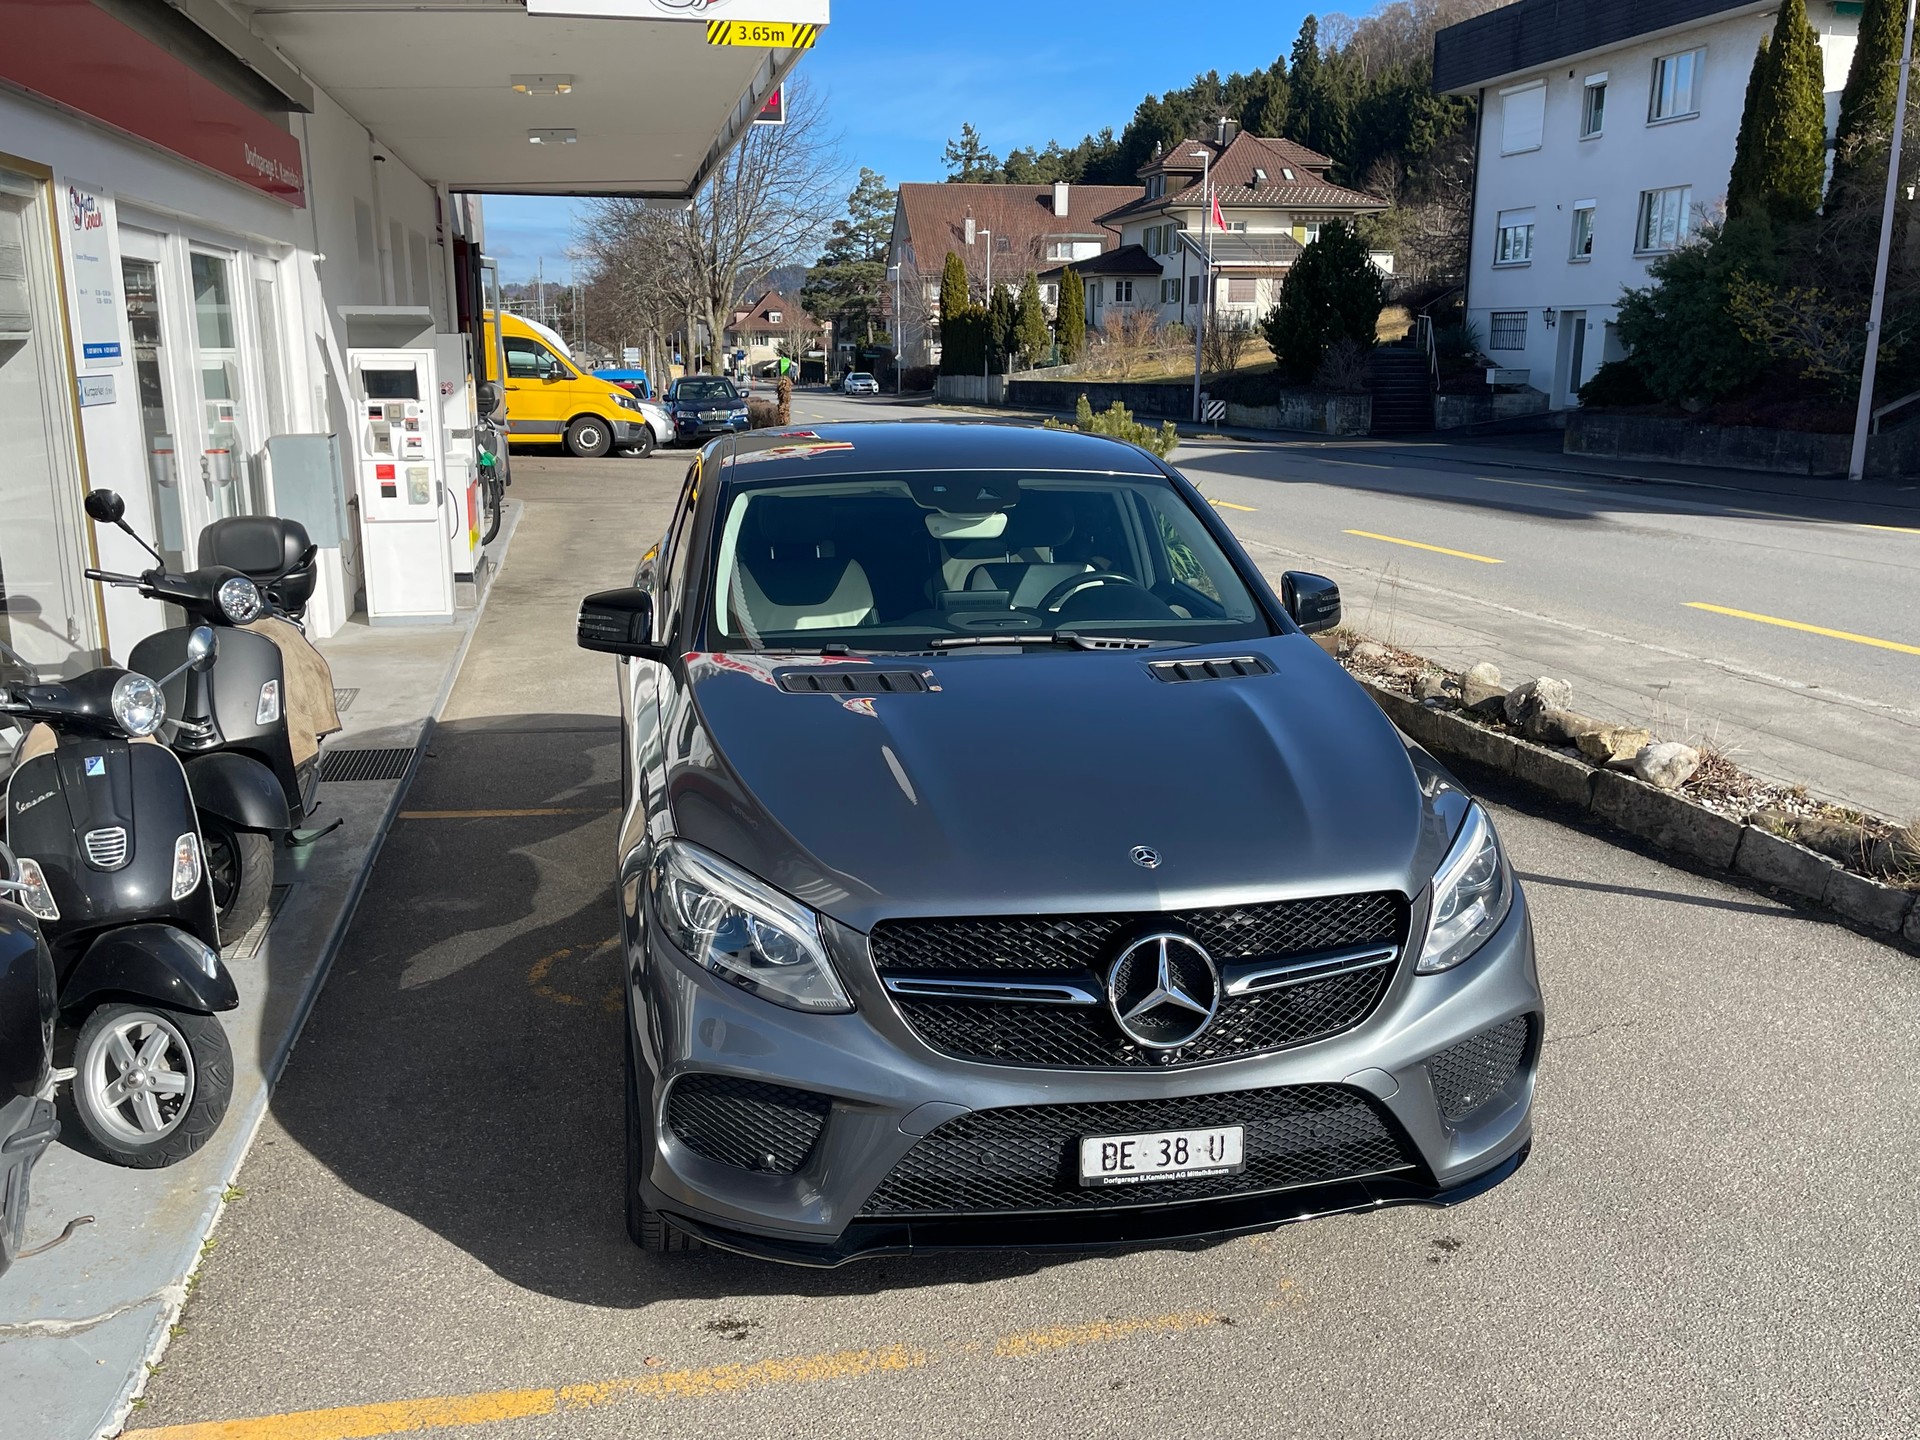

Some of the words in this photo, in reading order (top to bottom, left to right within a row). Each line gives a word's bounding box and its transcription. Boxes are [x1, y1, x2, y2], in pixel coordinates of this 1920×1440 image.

[738, 26, 785, 42] 3.65m
[1102, 1141, 1136, 1171] BE
[1156, 1137, 1190, 1168] 38
[1209, 1135, 1225, 1162] U
[1103, 1176, 1138, 1184] Dorfgarage
